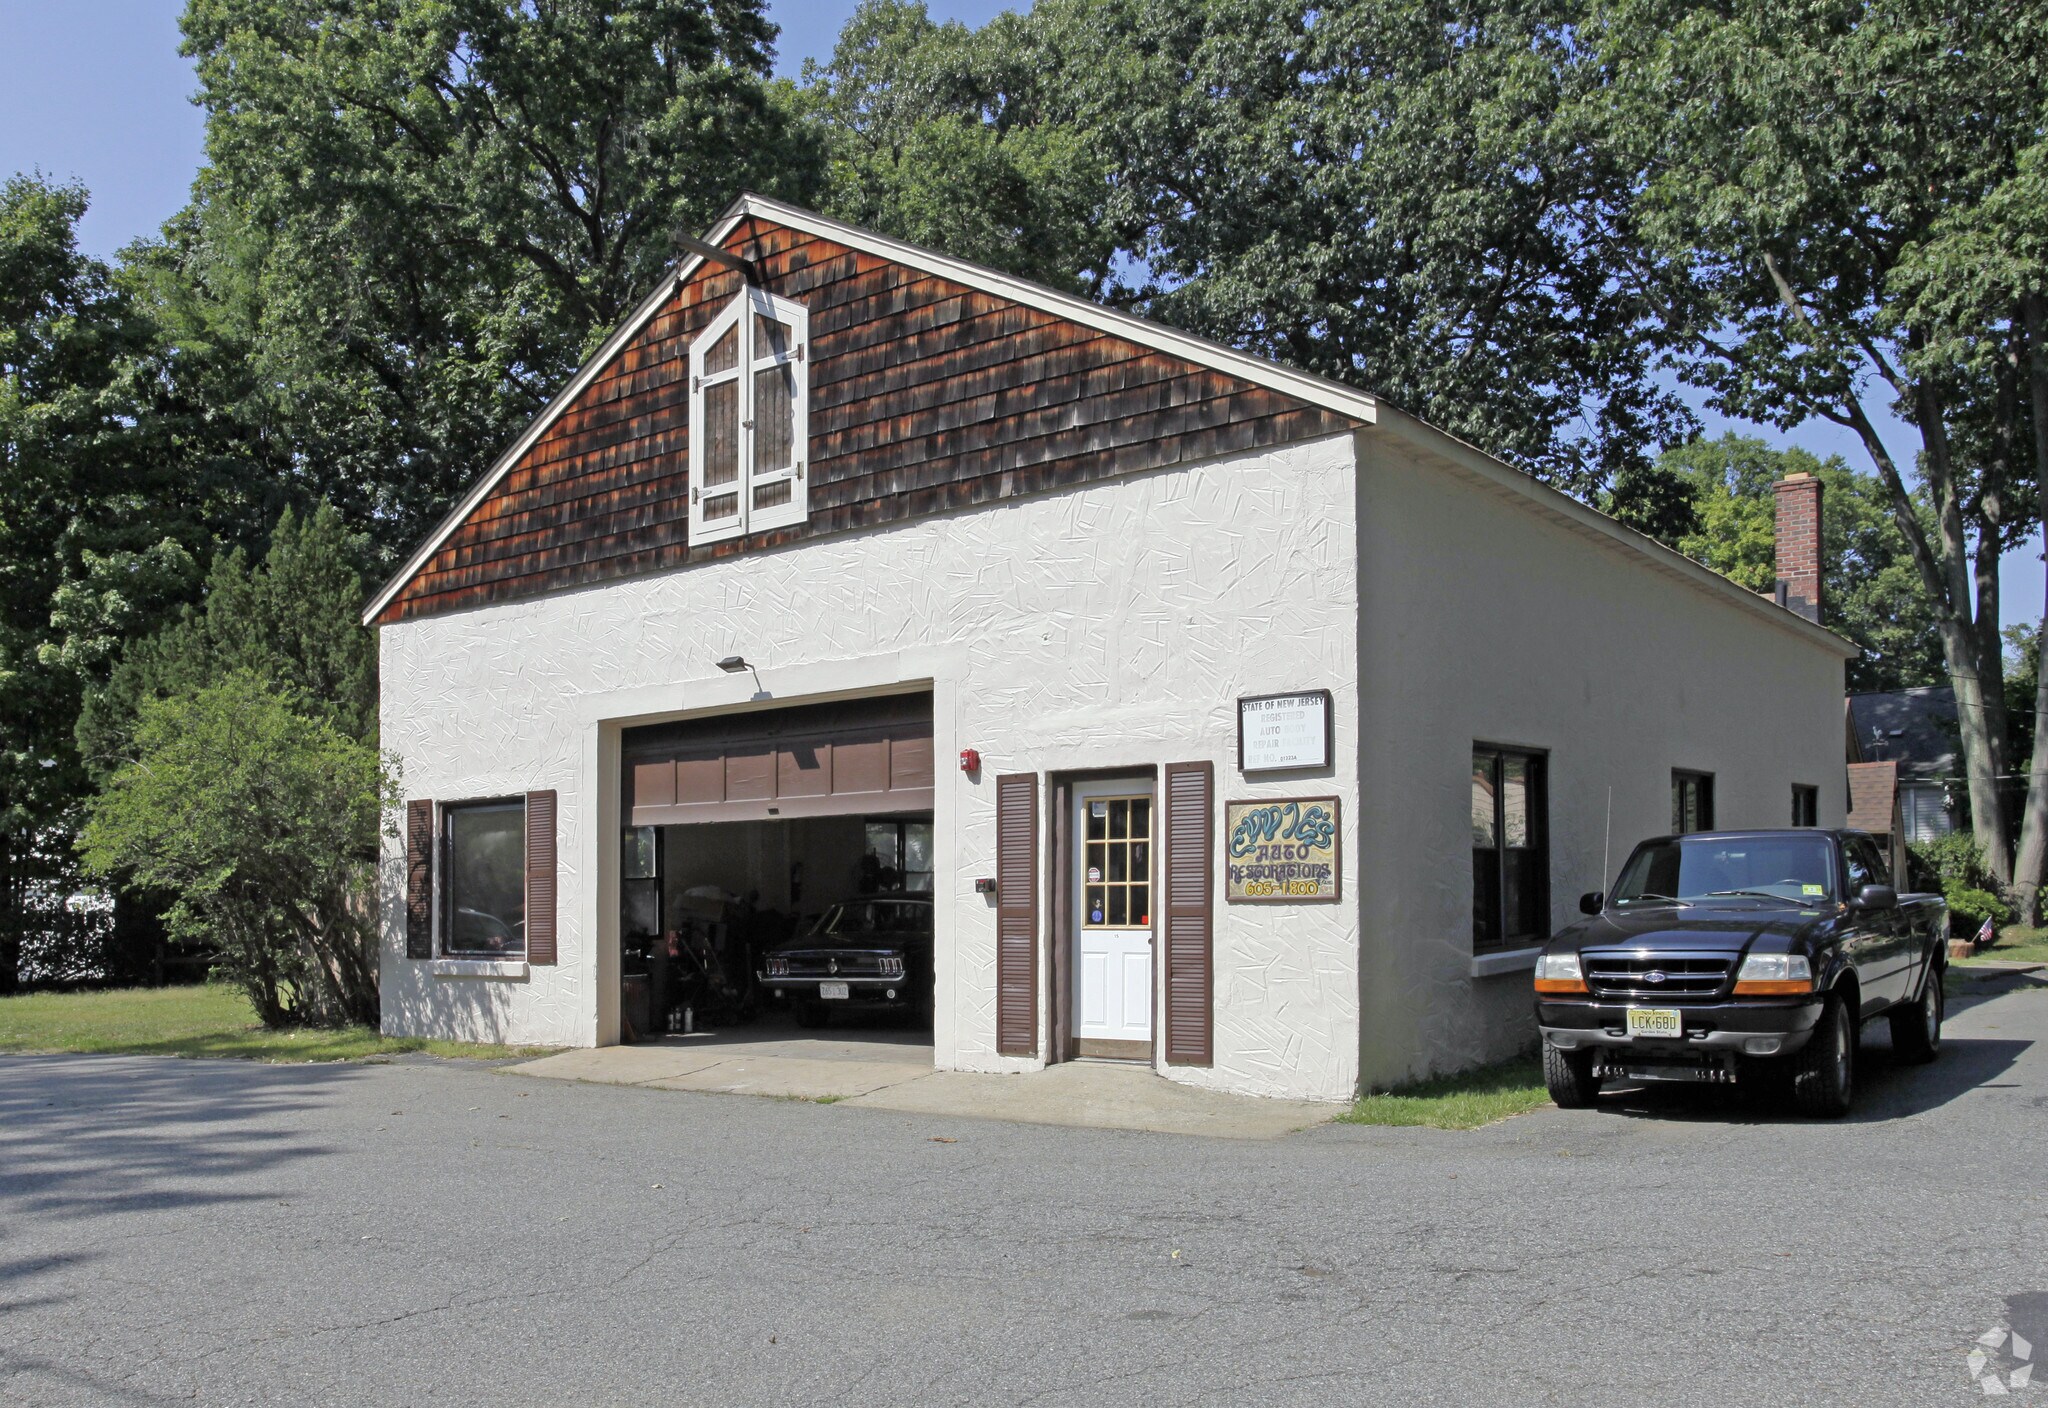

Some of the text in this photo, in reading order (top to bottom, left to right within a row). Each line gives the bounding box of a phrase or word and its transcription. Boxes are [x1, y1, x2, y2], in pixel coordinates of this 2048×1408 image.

[1242, 697, 1324, 712] STATE OF NEW JERSEY
[1260, 710, 1305, 722] REGISTERED
[1260, 725, 1281, 736] AUTO
[1253, 739, 1279, 749] REPAIR
[1255, 843, 1310, 862] AUTO
[1230, 863, 1332, 884] RESTORATIONS
[1245, 881, 1319, 896] 605-1800
